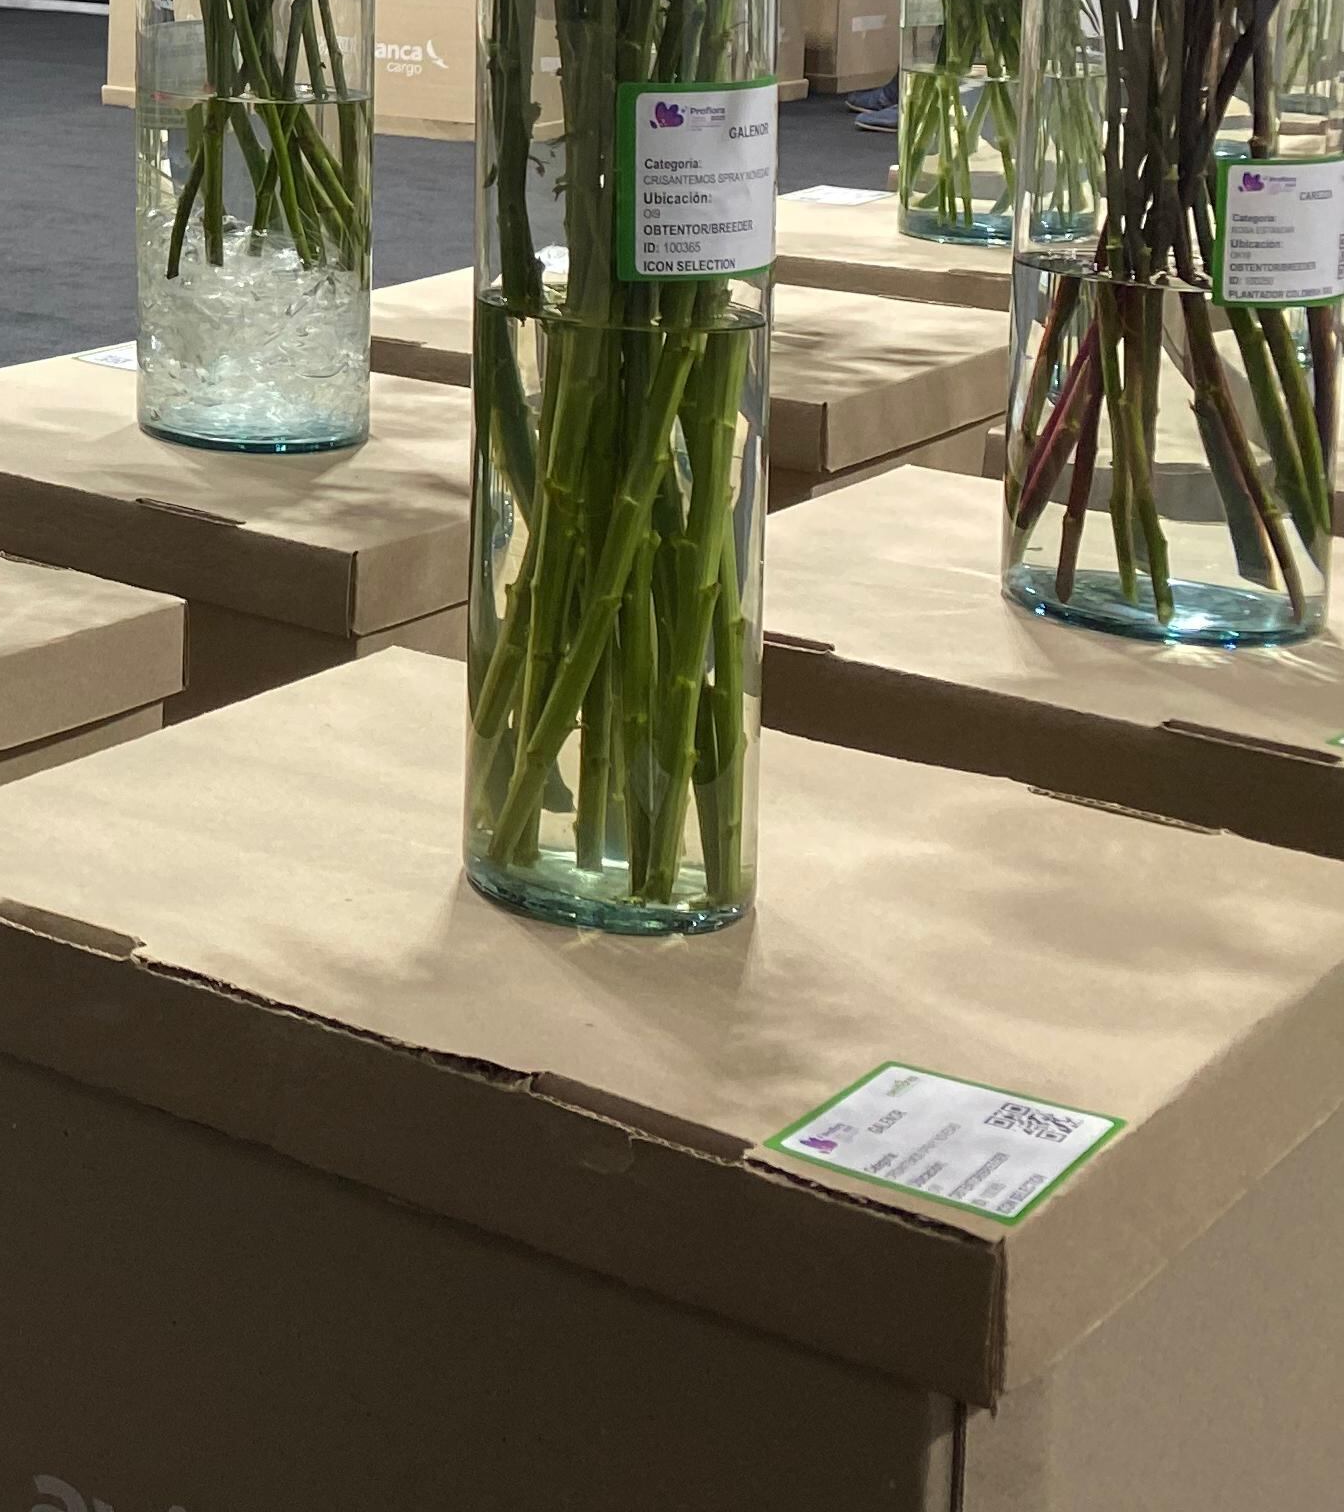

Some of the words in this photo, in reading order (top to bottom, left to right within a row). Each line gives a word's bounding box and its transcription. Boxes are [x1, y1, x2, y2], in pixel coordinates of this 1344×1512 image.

[375, 42, 423, 62] anca
[386, 62, 423, 77] cargo
[729, 122, 769, 139] GALENOR
[643, 174, 716, 186] CRISANTEMOS
[718, 171, 744, 184] SPRAY
[643, 191, 712, 205] Ubicación:
[643, 219, 753, 236] OBTENTOR/BREEDER
[643, 242, 660, 254] ID:
[663, 241, 701, 254] 100365
[643, 260, 674, 273] ICON
[676, 258, 736, 272] SELECTION
